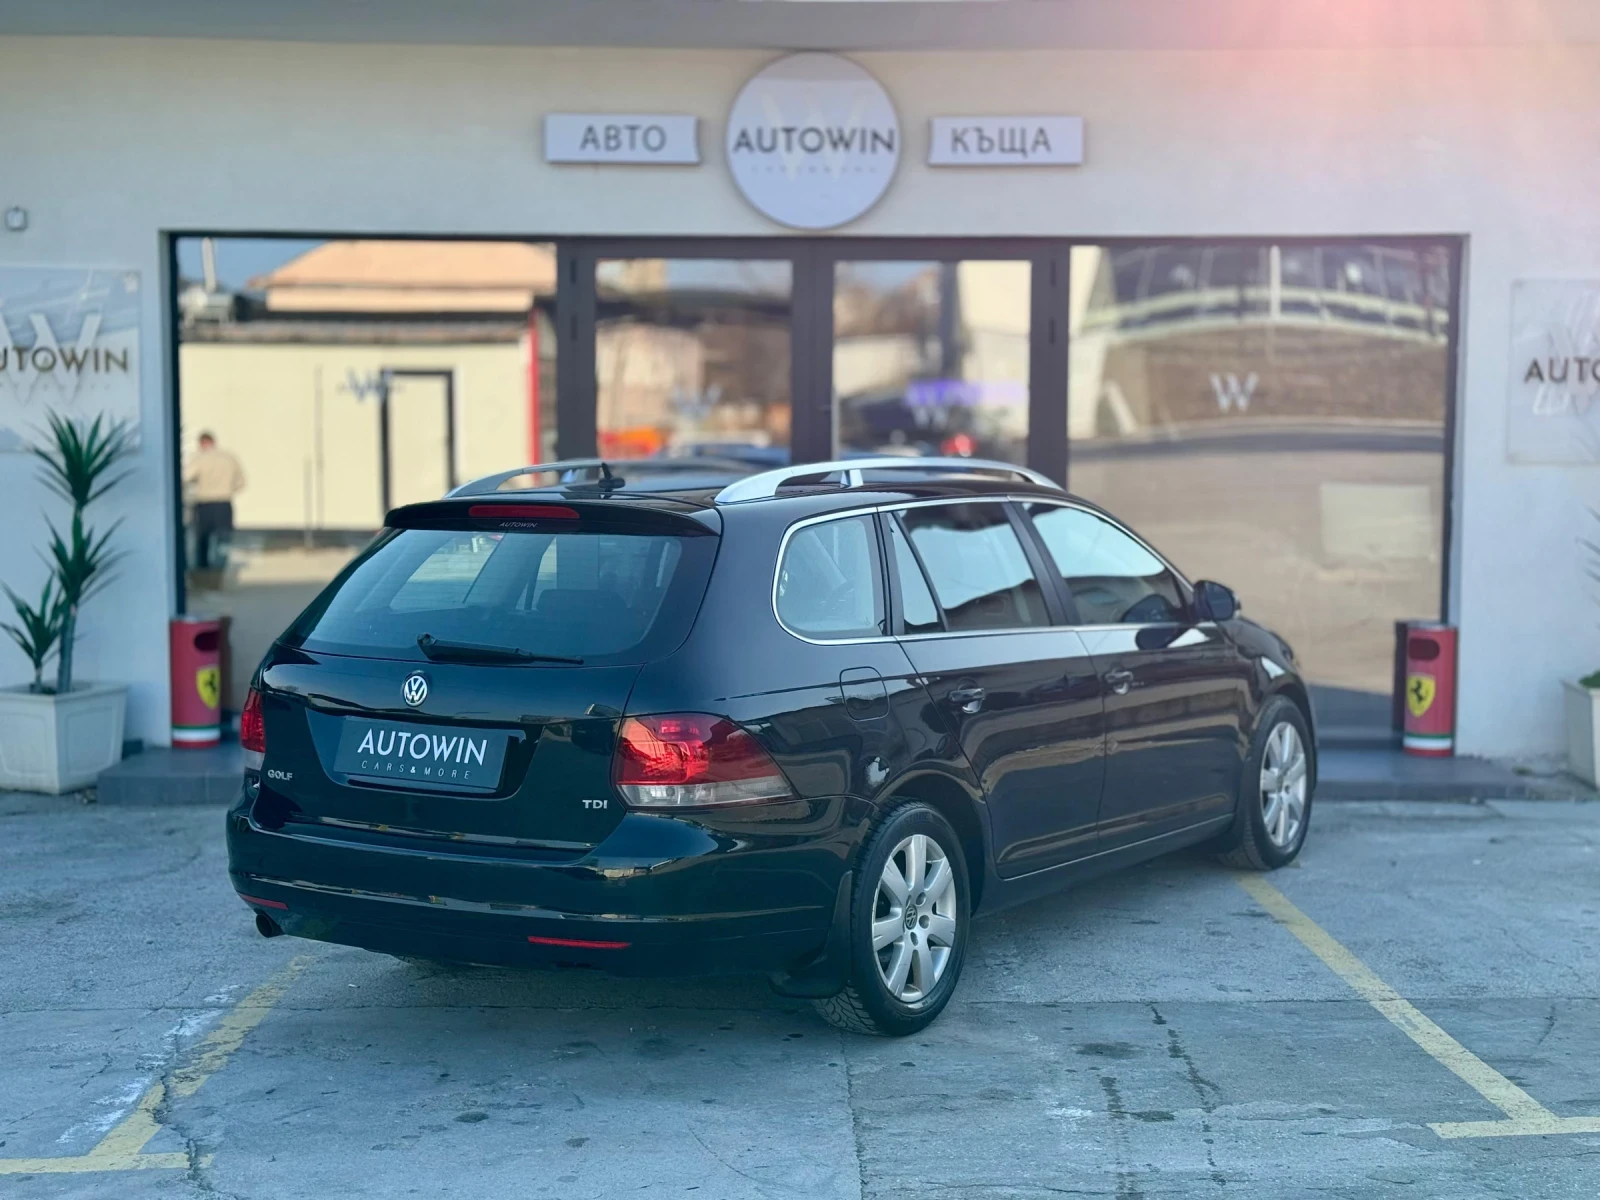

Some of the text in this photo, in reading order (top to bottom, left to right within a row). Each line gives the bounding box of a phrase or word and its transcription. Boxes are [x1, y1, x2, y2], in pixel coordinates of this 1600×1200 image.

[579, 124, 668, 152] АВТО
[732, 126, 896, 154] AUTOWIN
[950, 126, 1054, 159] КЪЩА
[499, 521, 538, 529] AUTOWIN
[357, 728, 488, 766] AUTOWIN
[267, 769, 293, 781] GOLF
[581, 799, 608, 809] TDI
